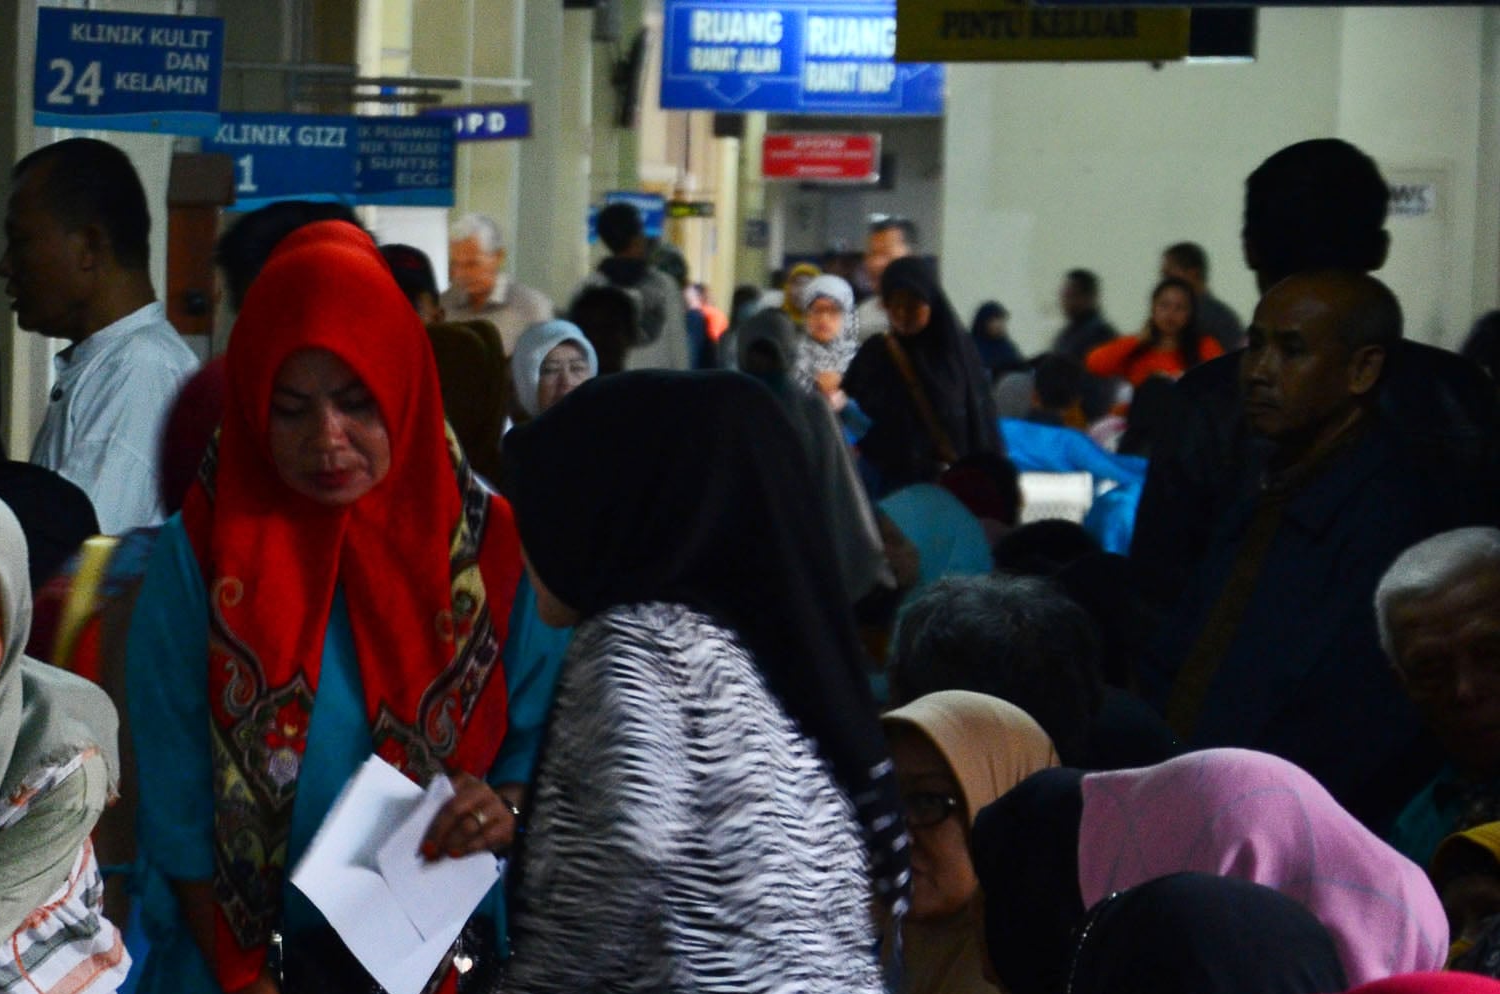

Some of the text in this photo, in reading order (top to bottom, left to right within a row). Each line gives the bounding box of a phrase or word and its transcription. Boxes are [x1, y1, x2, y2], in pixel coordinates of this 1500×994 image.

[70, 22, 212, 48] KLINIK KULIT
[690, 9, 783, 44] RUANG
[807, 16, 897, 57] RUANG
[165, 52, 209, 72] DAN
[46, 57, 104, 107] 24
[113, 72, 208, 95] KELAMIN
[214, 124, 291, 146] KLINIK
[296, 125, 349, 148] GIZI
[235, 153, 258, 193] 1
